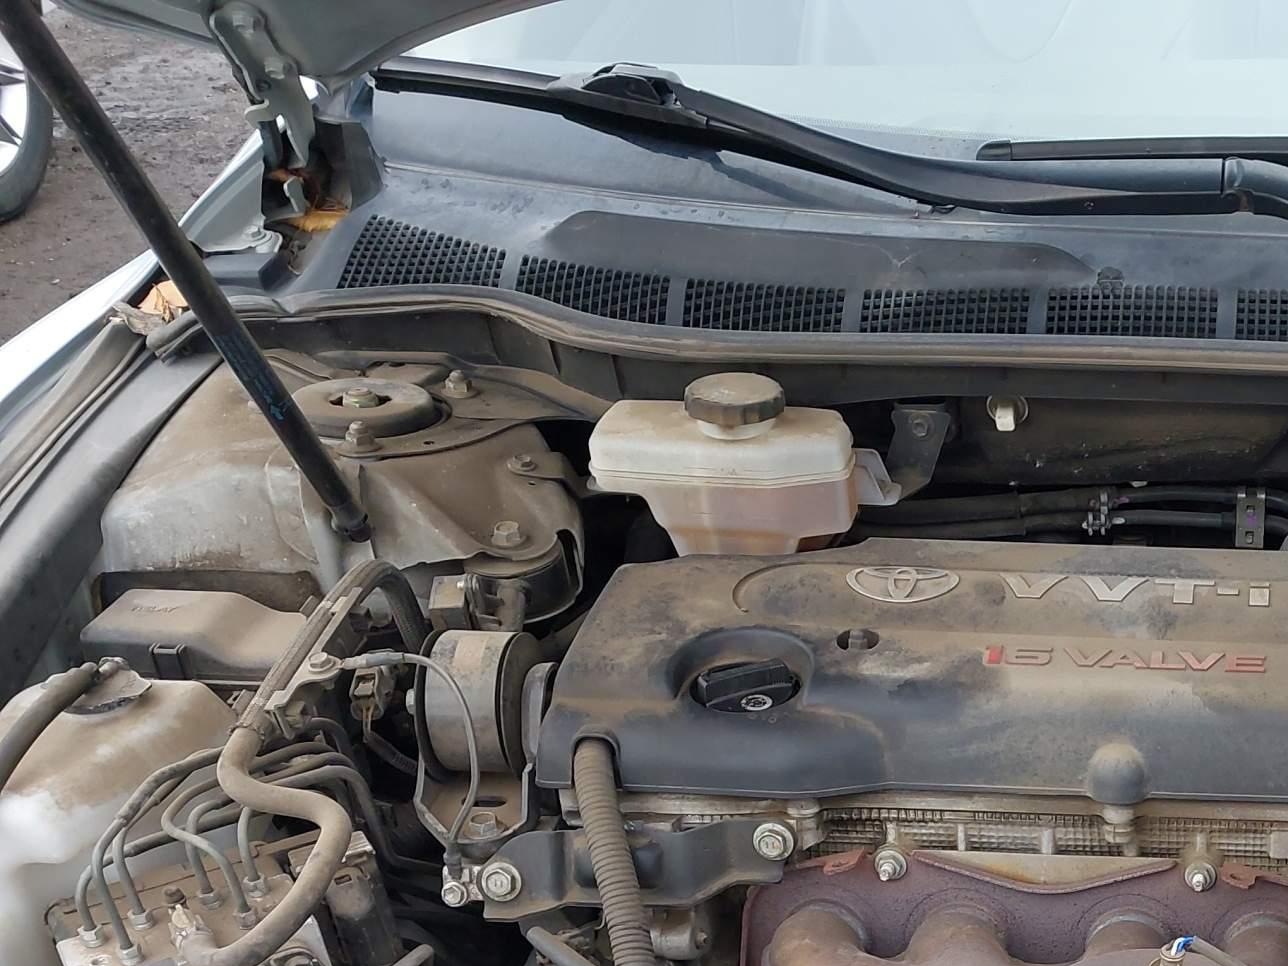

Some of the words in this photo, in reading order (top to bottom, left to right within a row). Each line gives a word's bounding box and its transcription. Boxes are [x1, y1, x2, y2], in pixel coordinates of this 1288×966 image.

[1001, 575, 1271, 607] VVT-i
[982, 645, 1055, 668] 16
[1063, 646, 1267, 673] VALVE
